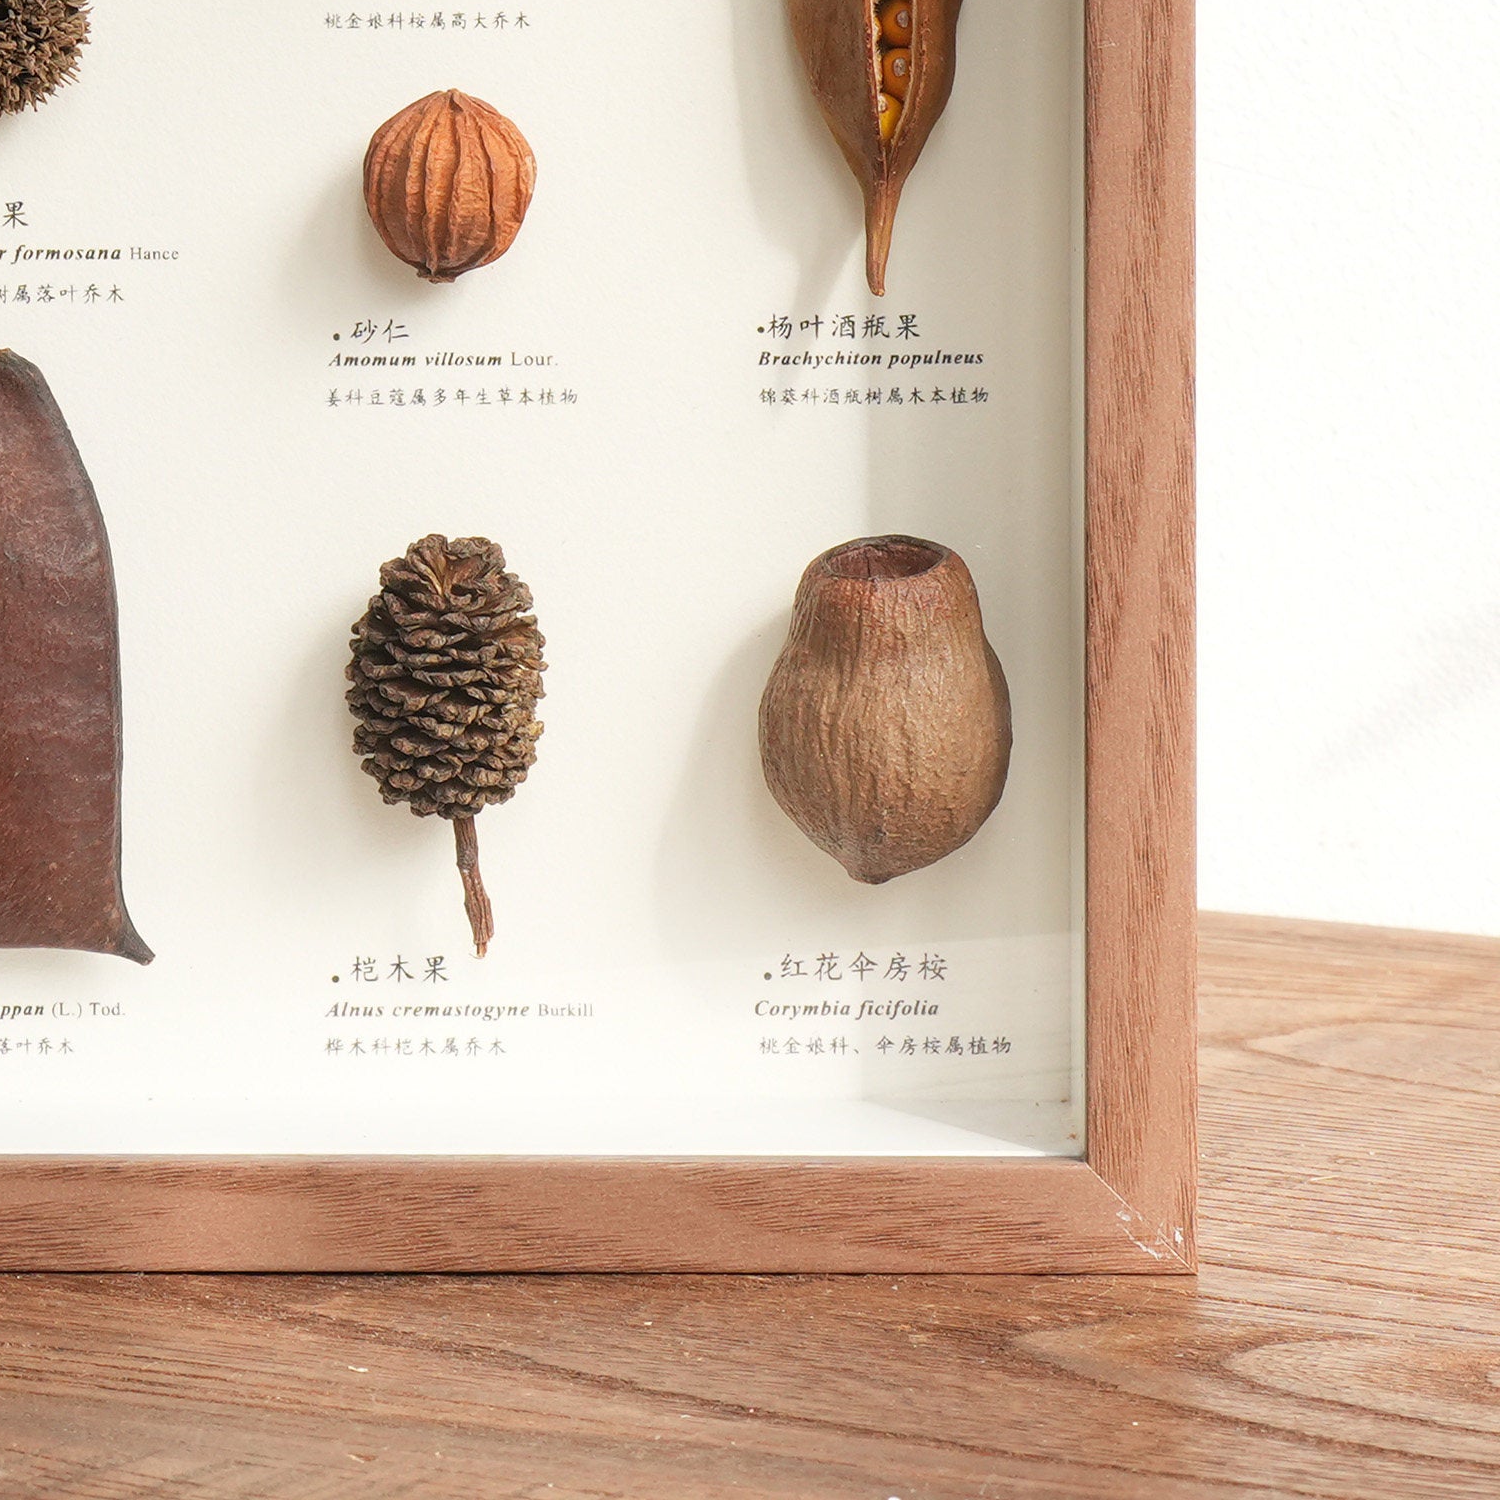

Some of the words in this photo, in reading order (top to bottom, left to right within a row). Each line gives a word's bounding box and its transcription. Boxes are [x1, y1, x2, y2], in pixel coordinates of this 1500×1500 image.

[324, 10, 531, 30] 桃金娘科桉属高大乔木
[11, 243, 122, 265] formosana
[129, 246, 180, 262] Hance
[349, 318, 411, 345] 砂仁
[766, 313, 921, 341] 杨叶酒瓶果
[327, 351, 417, 367] Amomum
[424, 351, 503, 367] villosum
[510, 351, 559, 367] Lour.
[757, 350, 882, 369] Brachychiton
[887, 349, 985, 369] populneus
[324, 387, 579, 408] 姜科豆蔻属多年生草本植物
[758, 386, 990, 406] 锦葵科酒瓶树属木本植物
[350, 954, 450, 984] 桤木果
[779, 950, 950, 983] 红花伞房桉
[51, 1001, 83, 1019] (L.)
[88, 1001, 126, 1017] Tod.
[324, 1001, 385, 1018] Alnus
[391, 1003, 530, 1022] cremastogyne
[537, 1002, 594, 1017] Burkill
[754, 999, 851, 1021] Corymbia
[855, 999, 940, 1021] ficifolia
[324, 1036, 507, 1057] 桦木科桤木属乔木
[759, 1035, 1012, 1057] 桃金娘科、伞房桉属植物
